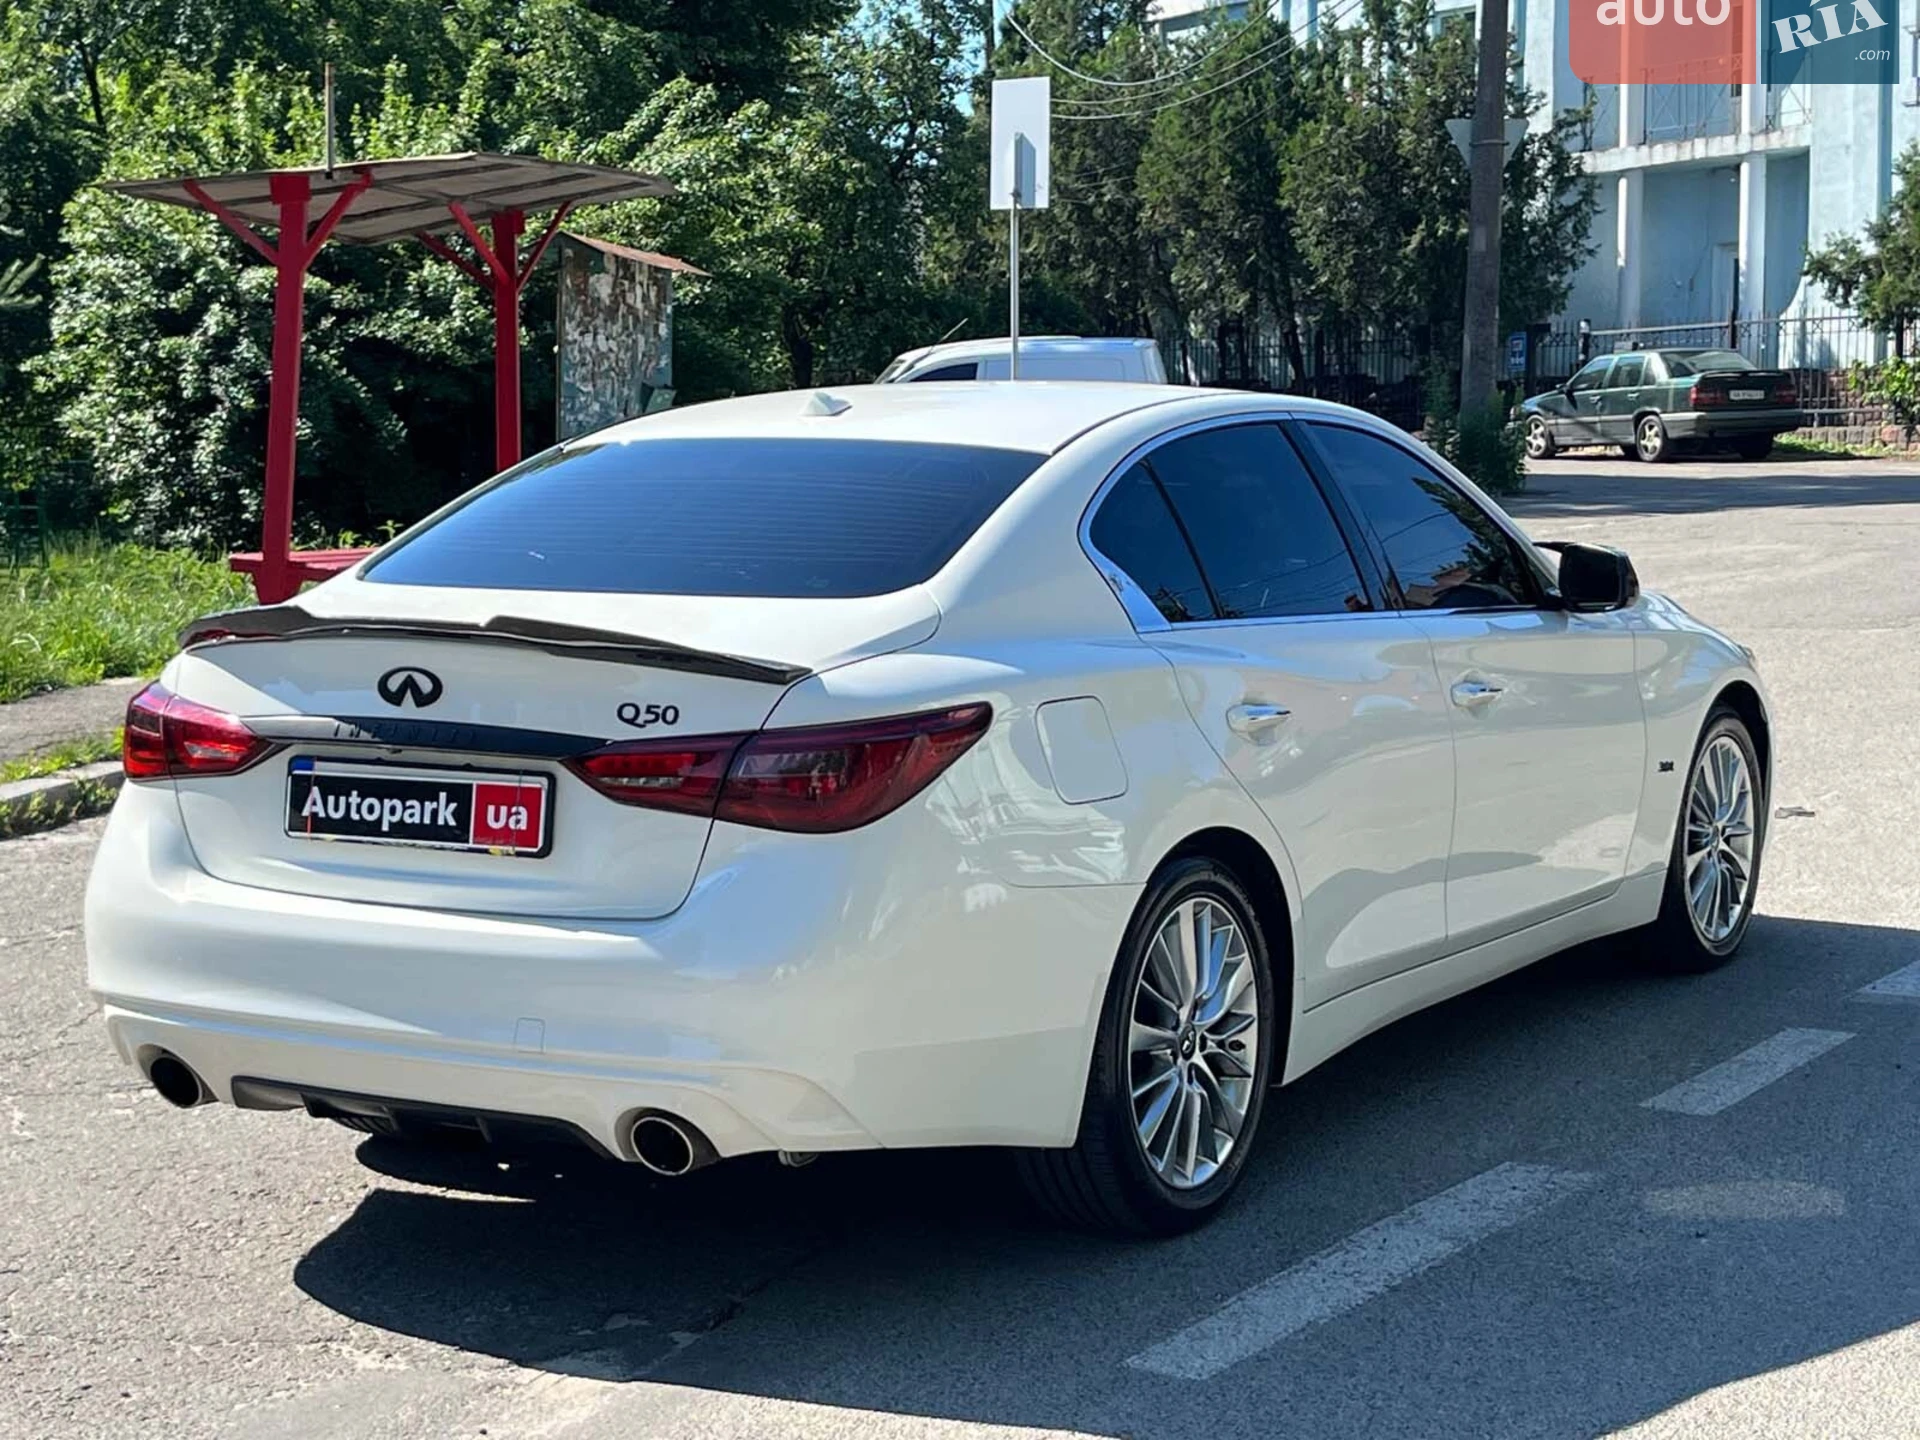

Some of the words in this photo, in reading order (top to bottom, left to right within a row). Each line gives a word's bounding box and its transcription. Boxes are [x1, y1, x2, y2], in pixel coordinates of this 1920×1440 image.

[616, 702, 680, 729] Q50
[301, 786, 458, 832] Autopark
[486, 804, 529, 831] ua
